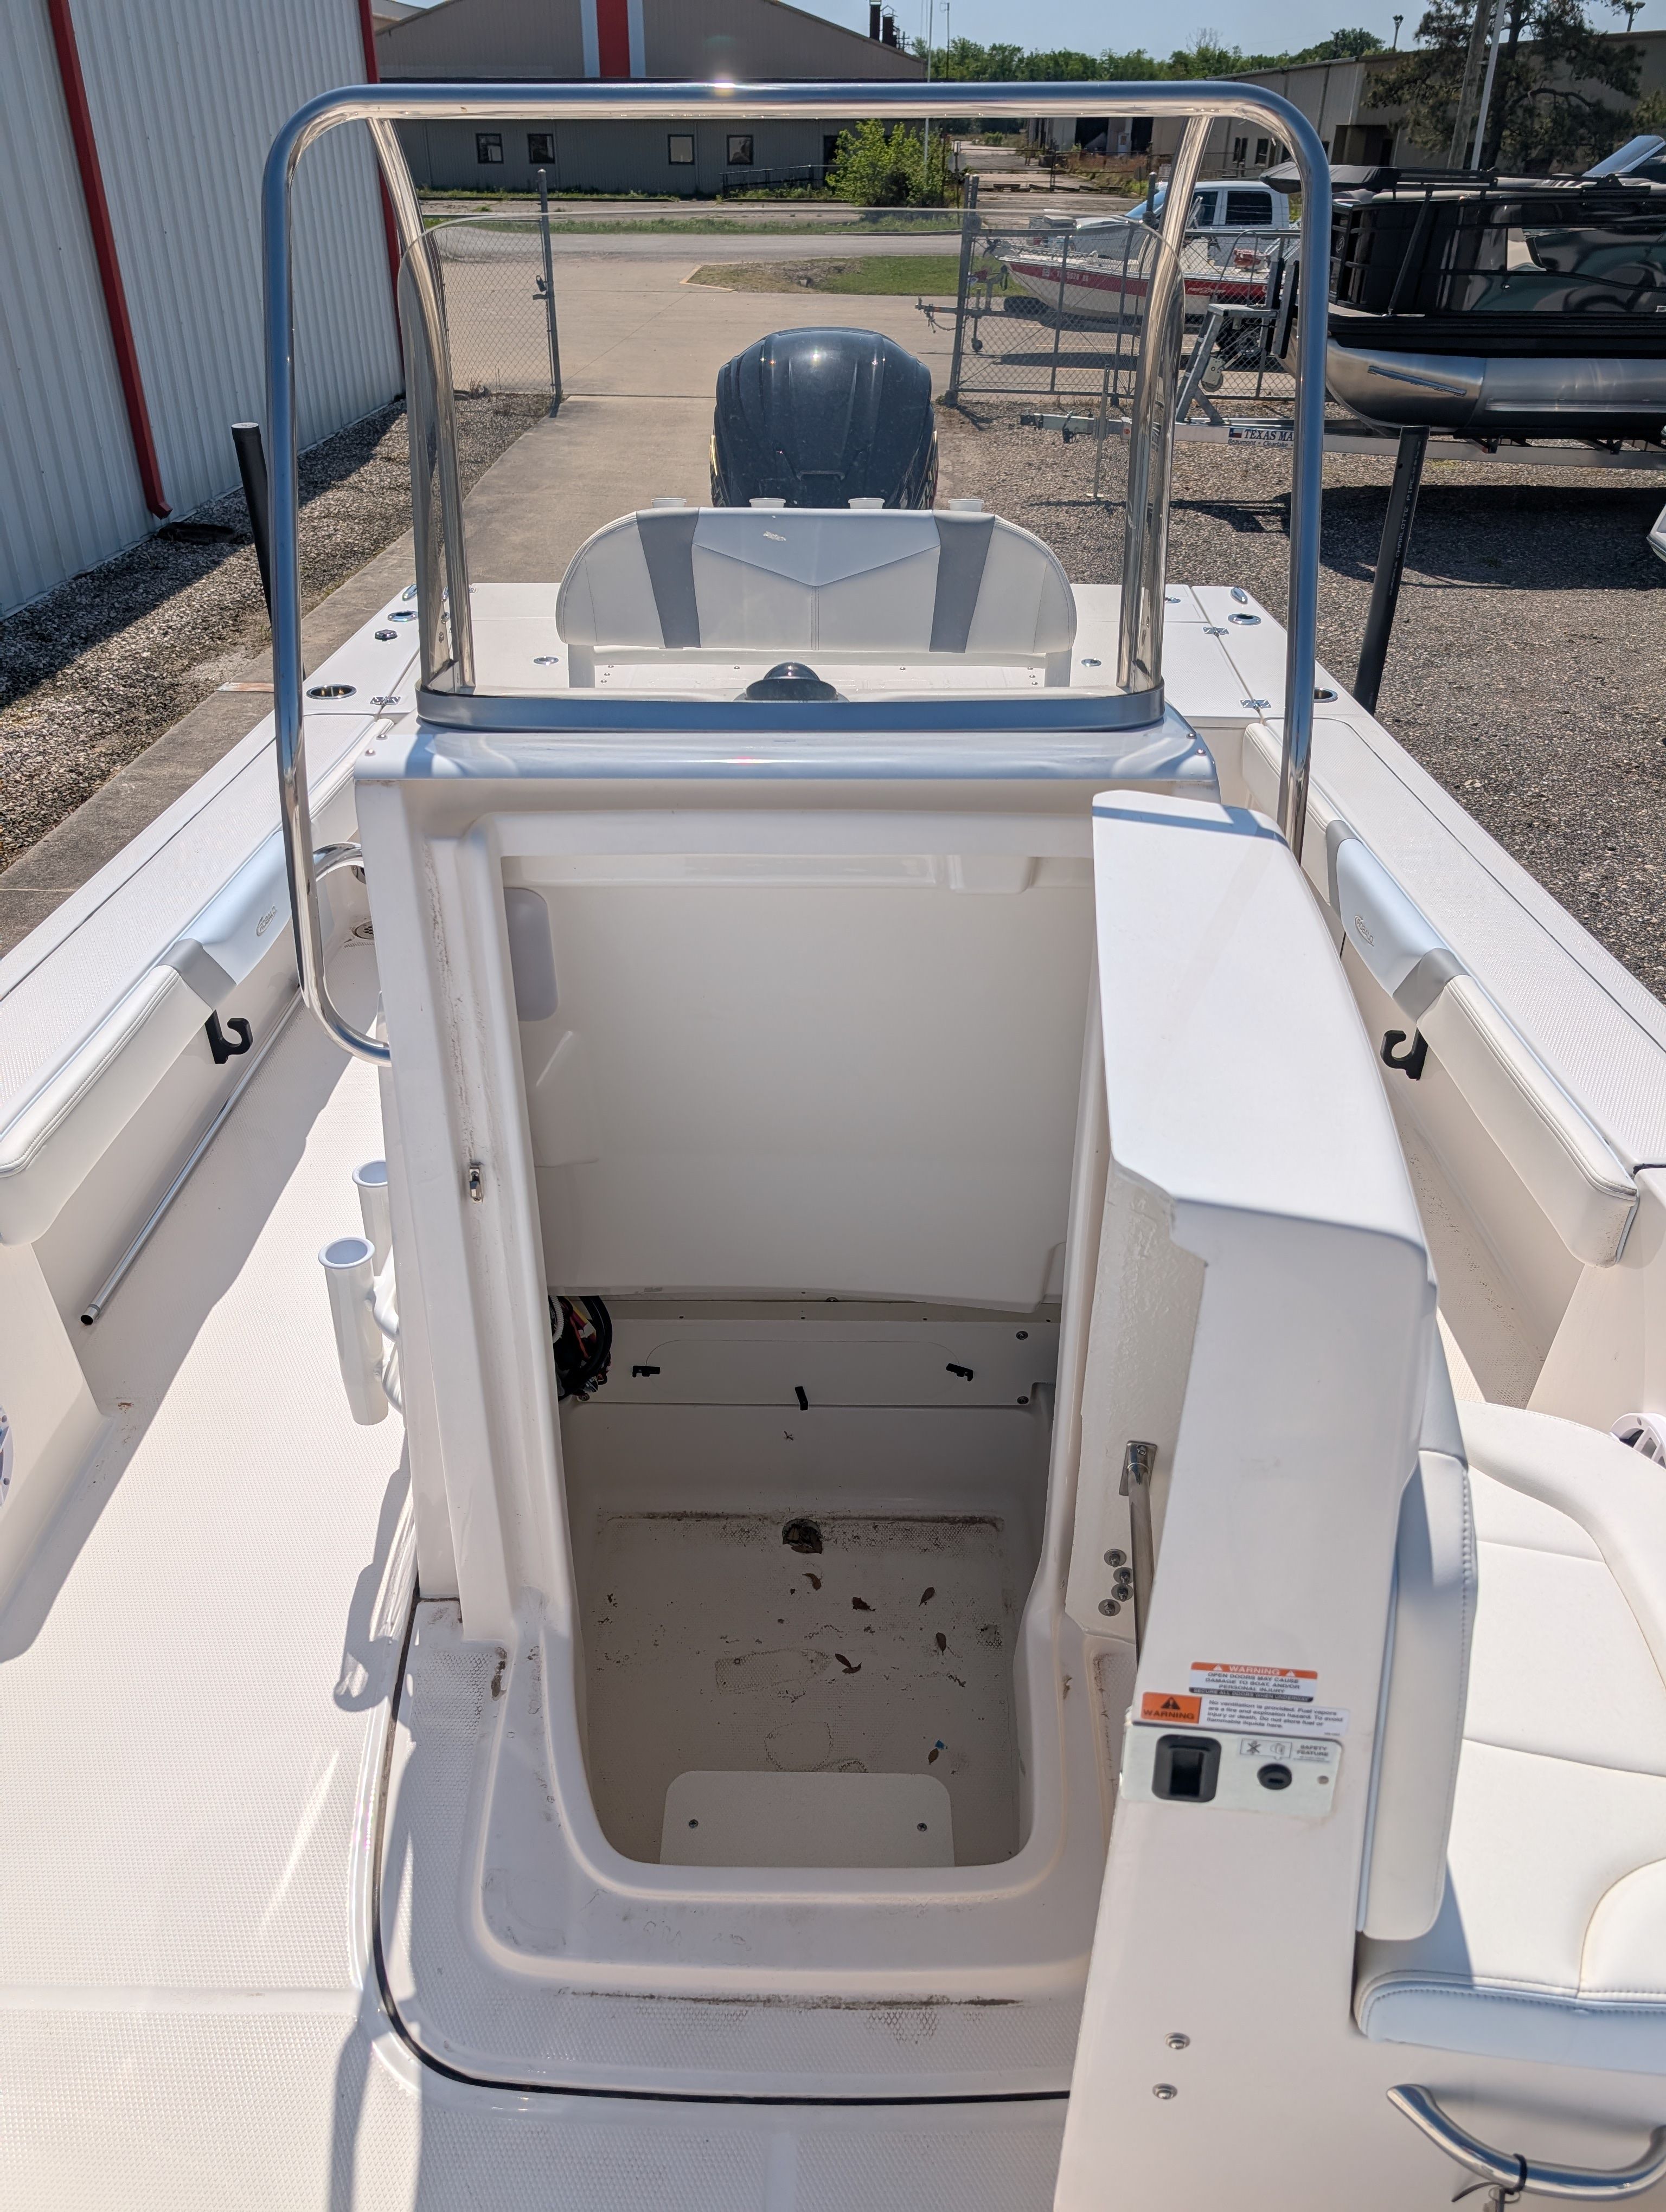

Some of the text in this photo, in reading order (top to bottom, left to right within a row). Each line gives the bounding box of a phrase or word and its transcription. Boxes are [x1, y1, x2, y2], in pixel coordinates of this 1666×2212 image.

[1244, 429, 1276, 440] TEXAS
[1395, 506, 1409, 558] CHARLOTTE
[1229, 1665, 1280, 1676] WARNING
[1144, 1709, 1194, 1719] WARNING
